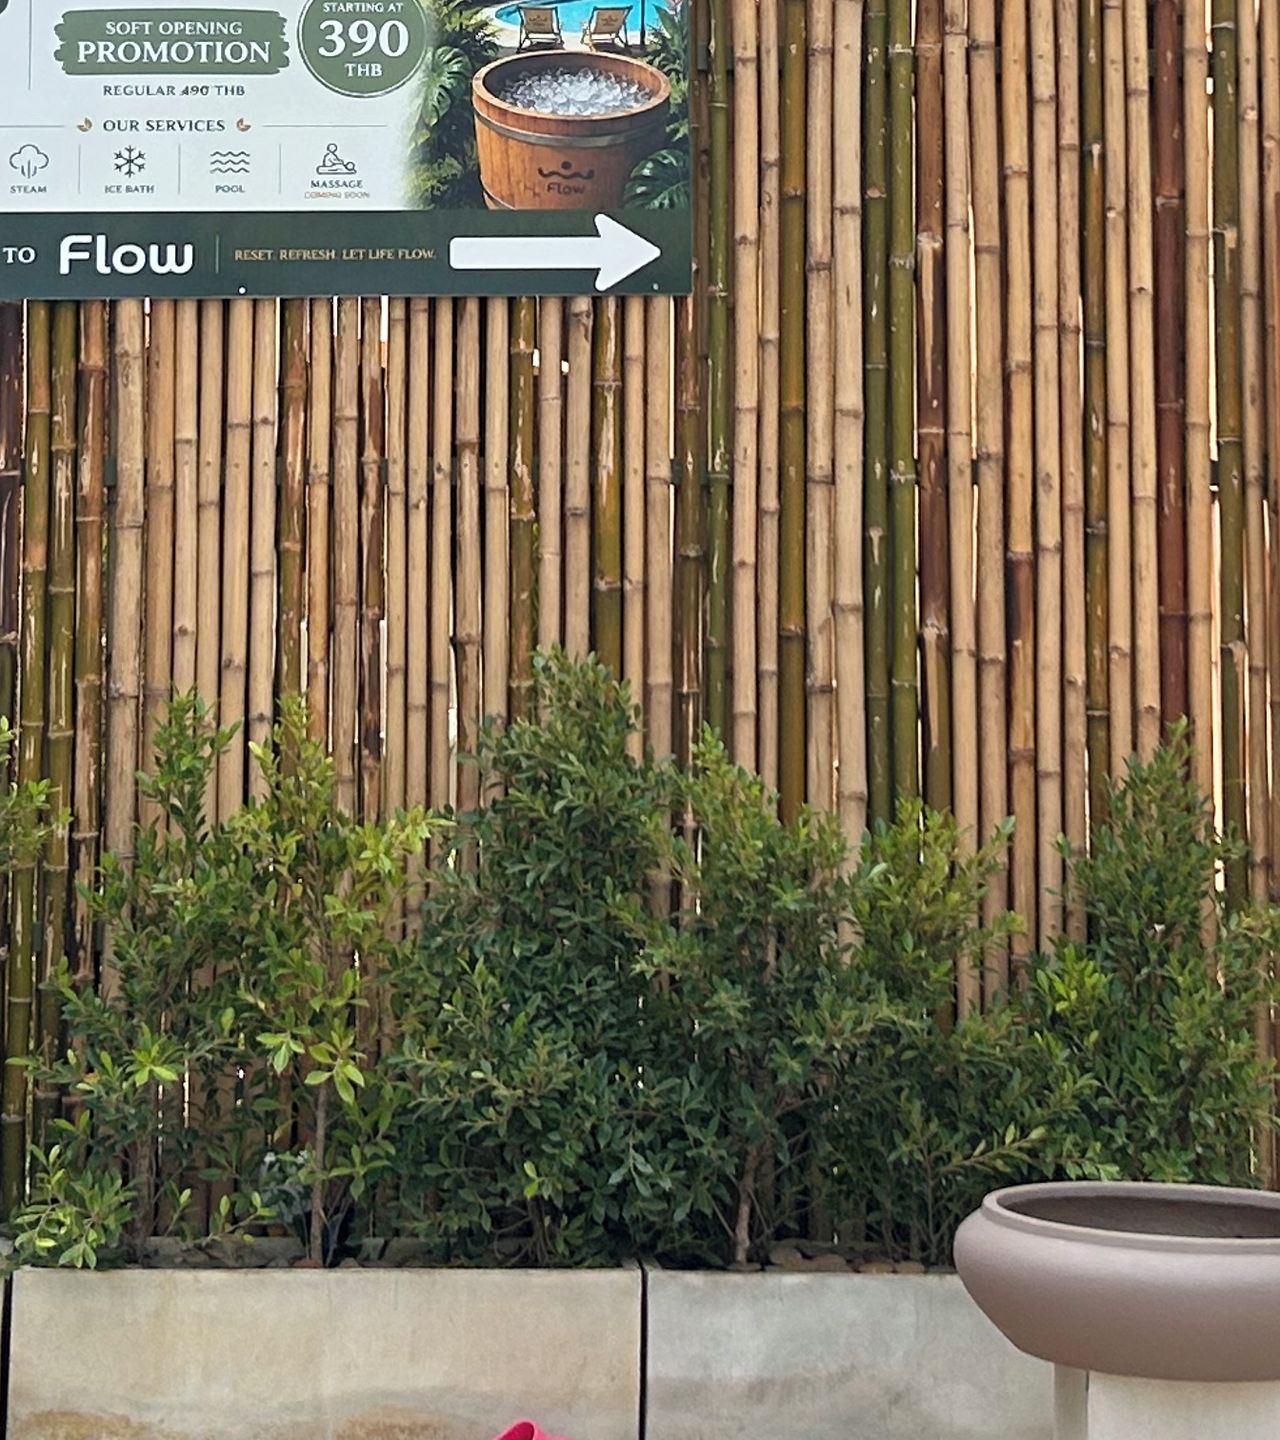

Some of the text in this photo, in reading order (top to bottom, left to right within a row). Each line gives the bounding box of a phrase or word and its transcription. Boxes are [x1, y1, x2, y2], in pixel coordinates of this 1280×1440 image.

[323, 2, 404, 13] STARTING AT
[105, 20, 243, 36] SOFT OPENING
[318, 19, 410, 58] 390
[76, 40, 271, 64] PROMOTION
[344, 62, 383, 78] THB
[103, 85, 176, 96] REGULAR
[214, 85, 245, 96] THB
[102, 119, 226, 132] OUR SERVICES
[10, 185, 48, 194] STEAM
[104, 185, 155, 194] ICE BATH
[214, 184, 245, 193] POOL
[310, 179, 363, 189] MASSAGE
[546, 181, 586, 195] Flow
[3, 247, 37, 264] TO
[58, 234, 194, 275] Flow
[342, 248, 367, 260] LET
[369, 248, 394, 259] LIFE
